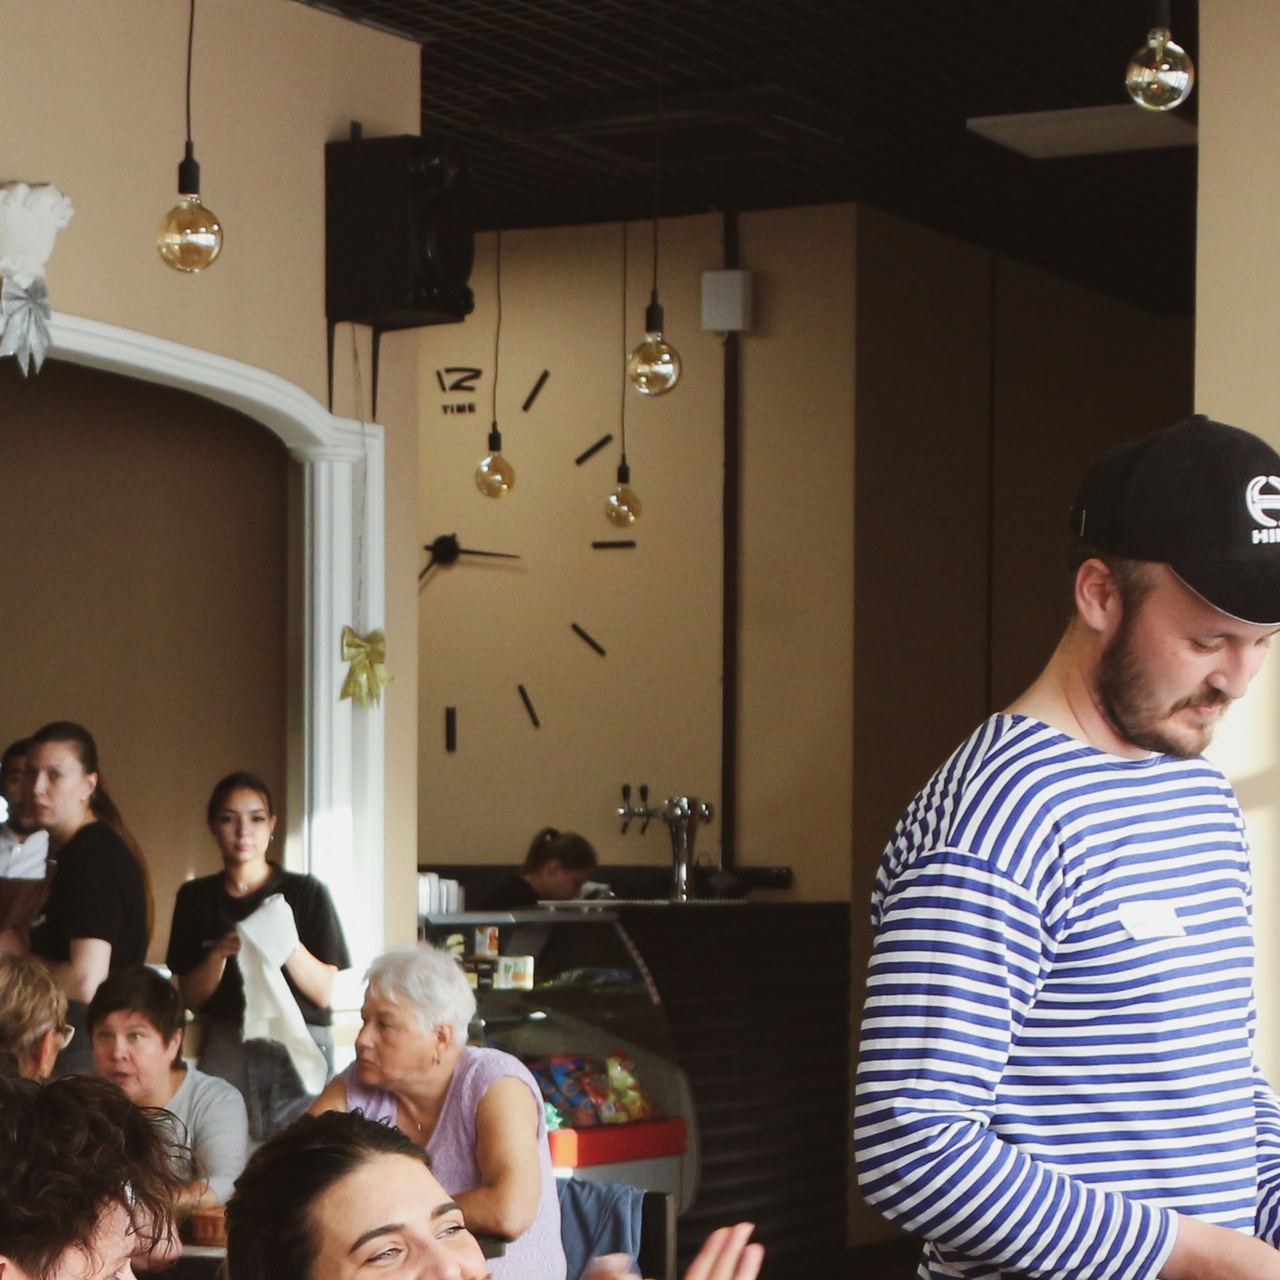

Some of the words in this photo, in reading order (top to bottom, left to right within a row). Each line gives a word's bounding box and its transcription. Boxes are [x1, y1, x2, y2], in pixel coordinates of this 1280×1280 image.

[436, 367, 483, 392] 12
[441, 403, 477, 414] TIME
[1251, 527, 1280, 545] HI
